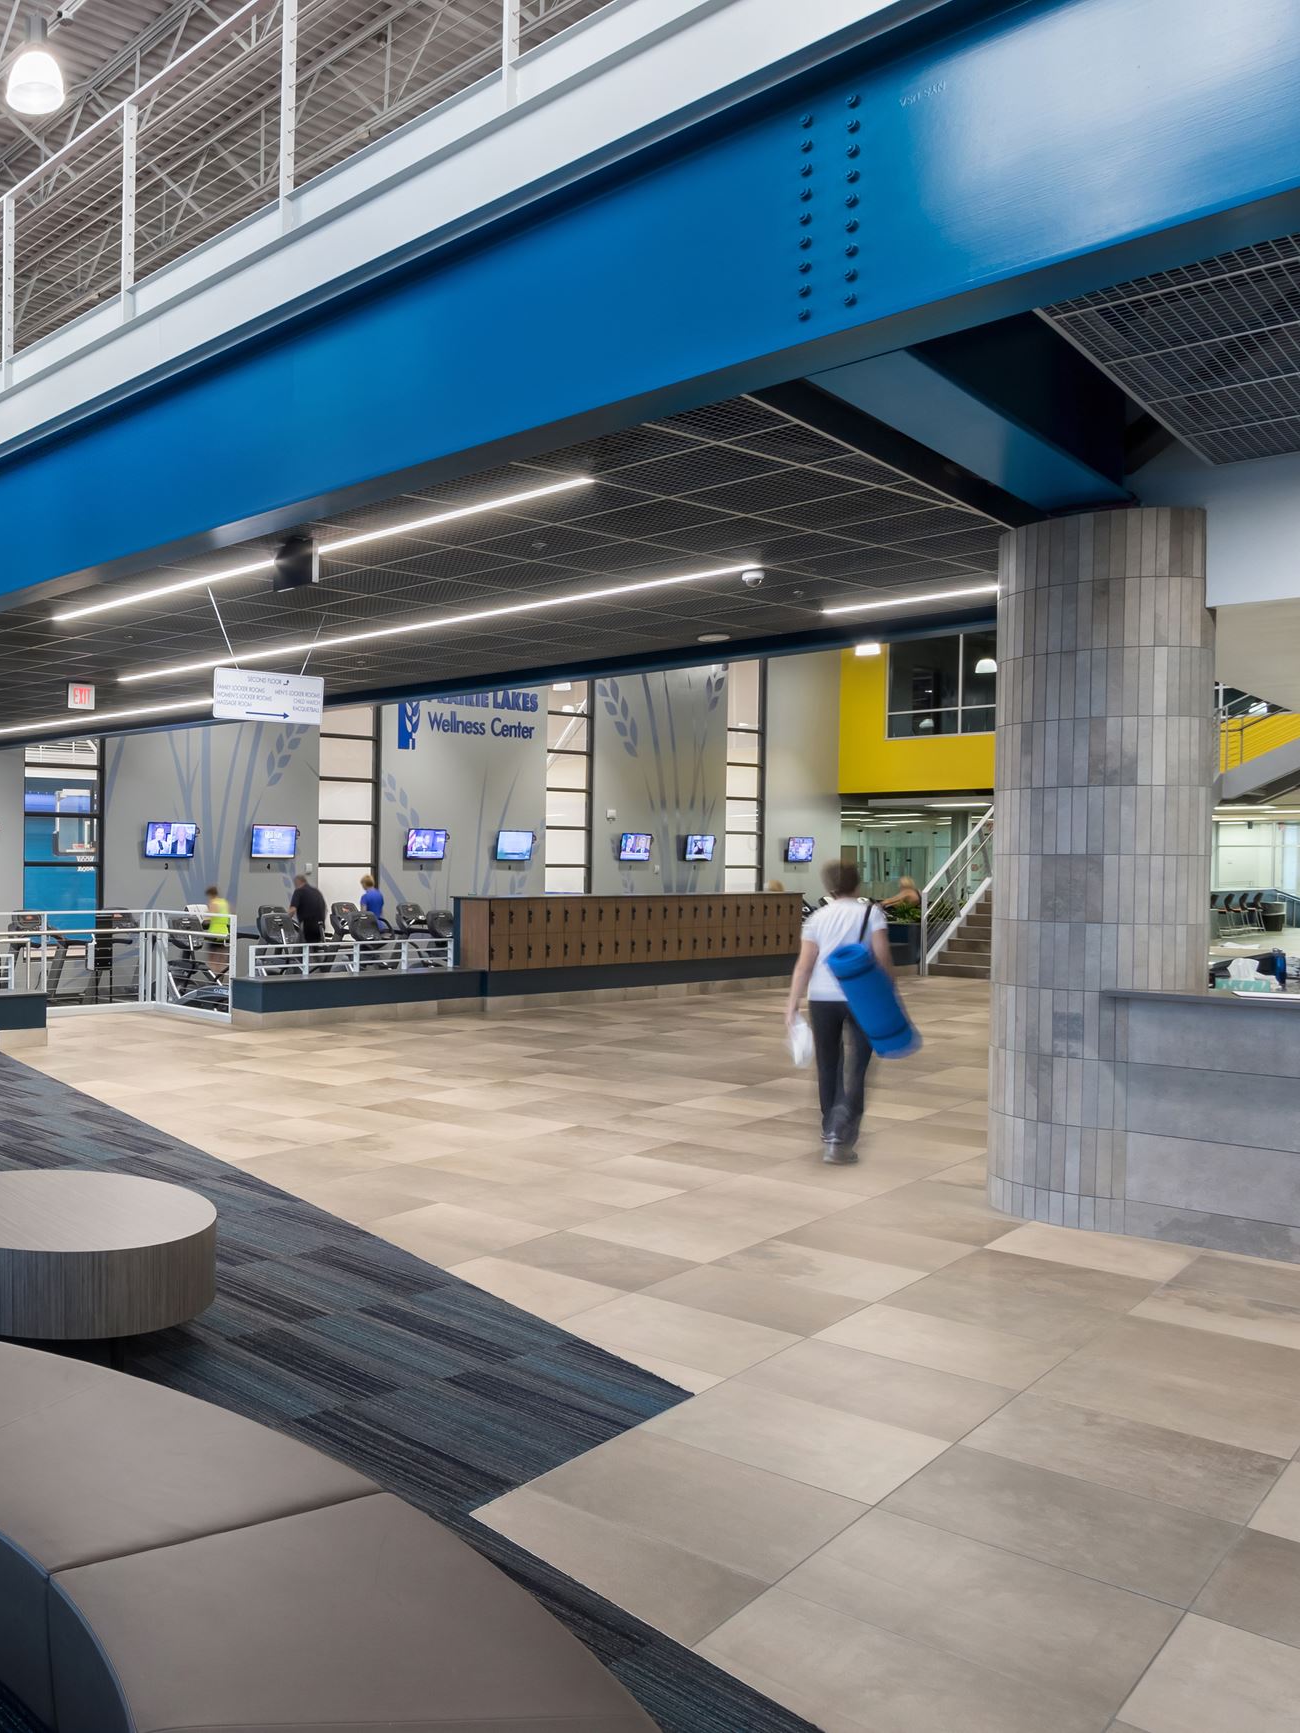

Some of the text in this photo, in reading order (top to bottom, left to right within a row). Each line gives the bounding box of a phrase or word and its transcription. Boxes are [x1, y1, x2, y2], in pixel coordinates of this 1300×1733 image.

[73, 687, 92, 705] EXIT
[492, 690, 539, 712] LAKES
[427, 710, 535, 739] Wellness Center
[164, 862, 169, 870] 3
